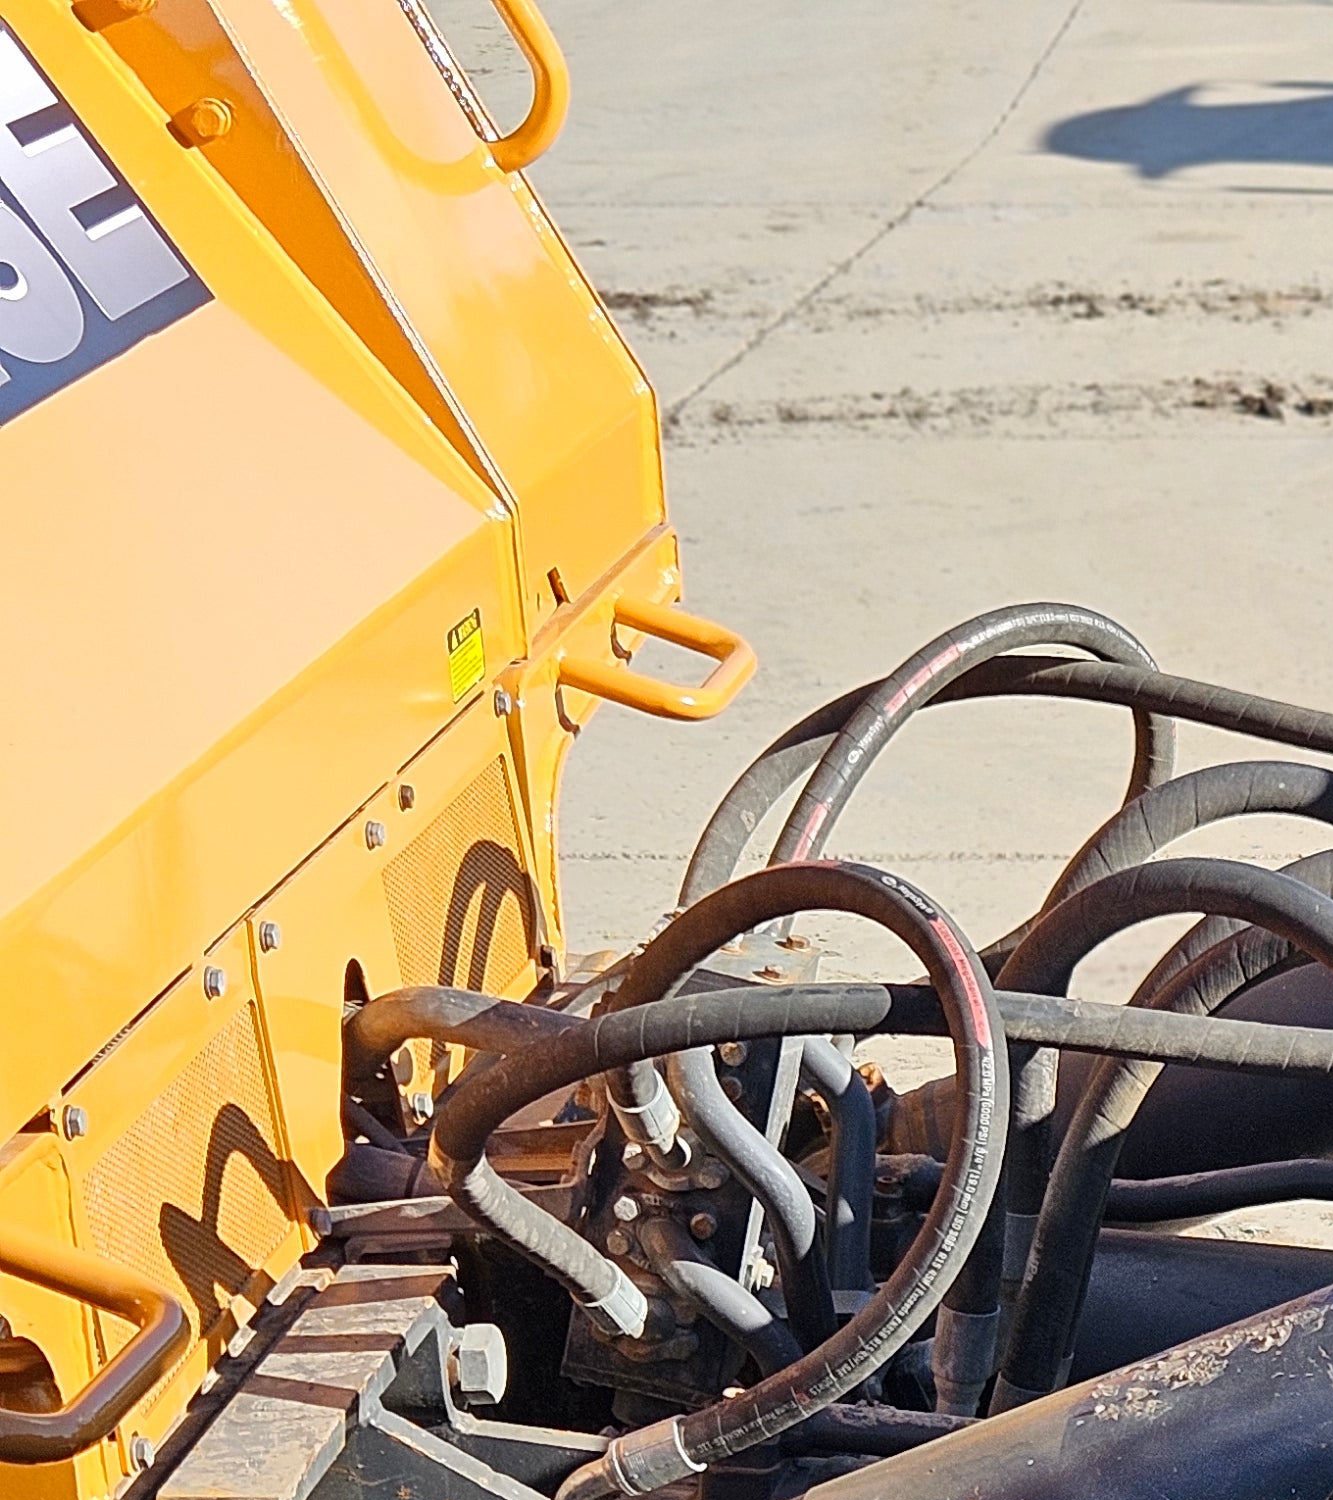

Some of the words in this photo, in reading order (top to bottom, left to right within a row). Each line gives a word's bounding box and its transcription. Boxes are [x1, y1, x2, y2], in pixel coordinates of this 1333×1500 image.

[982, 1077, 994, 1096] MPa
[979, 1097, 994, 1124] (6000
[974, 1125, 988, 1145] PSI)
[952, 1214, 966, 1230] ISO
[932, 1249, 948, 1269] R15
